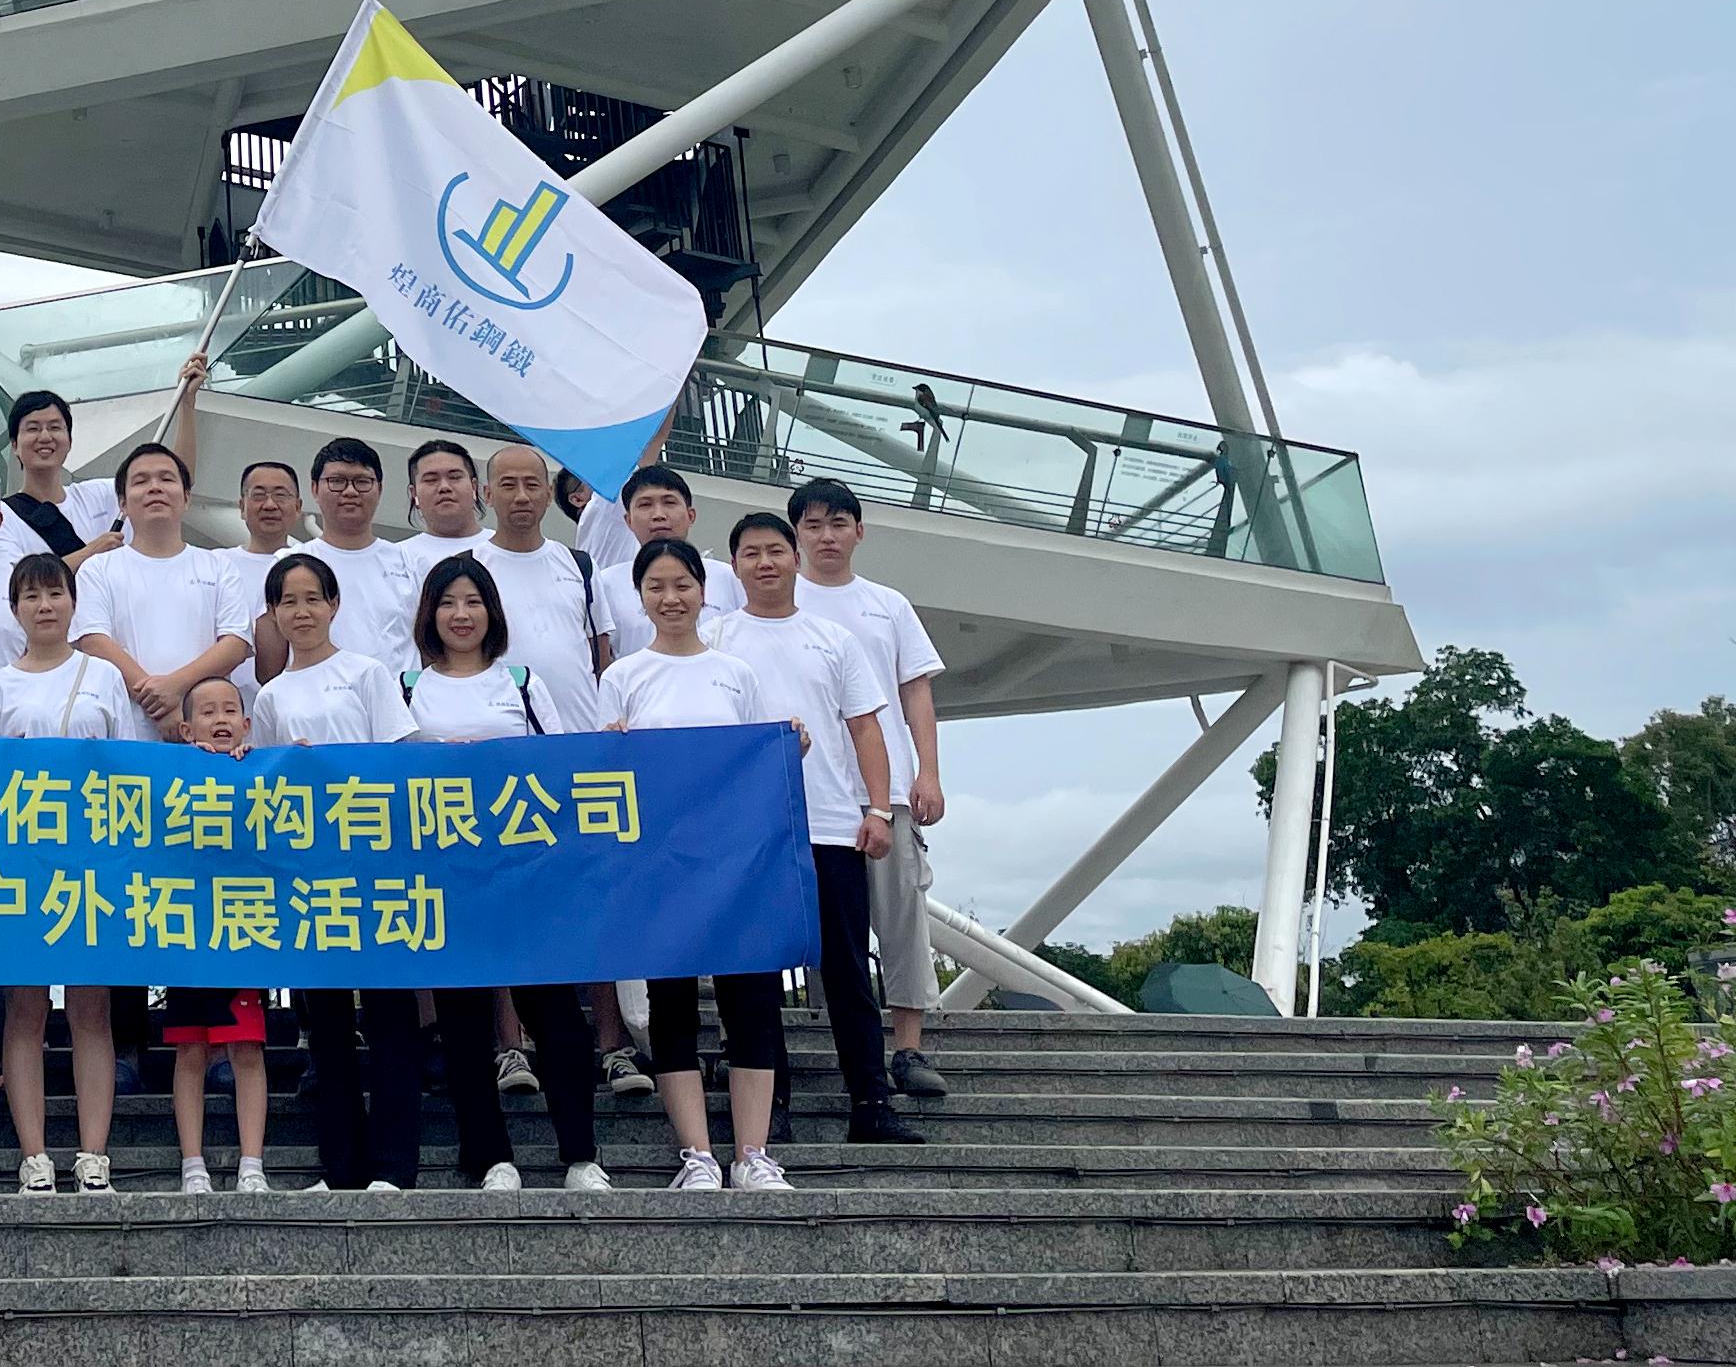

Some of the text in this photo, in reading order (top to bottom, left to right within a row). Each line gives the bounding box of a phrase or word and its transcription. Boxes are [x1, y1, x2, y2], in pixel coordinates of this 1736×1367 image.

[389, 263, 535, 378] 煌商佑鋼鐵
